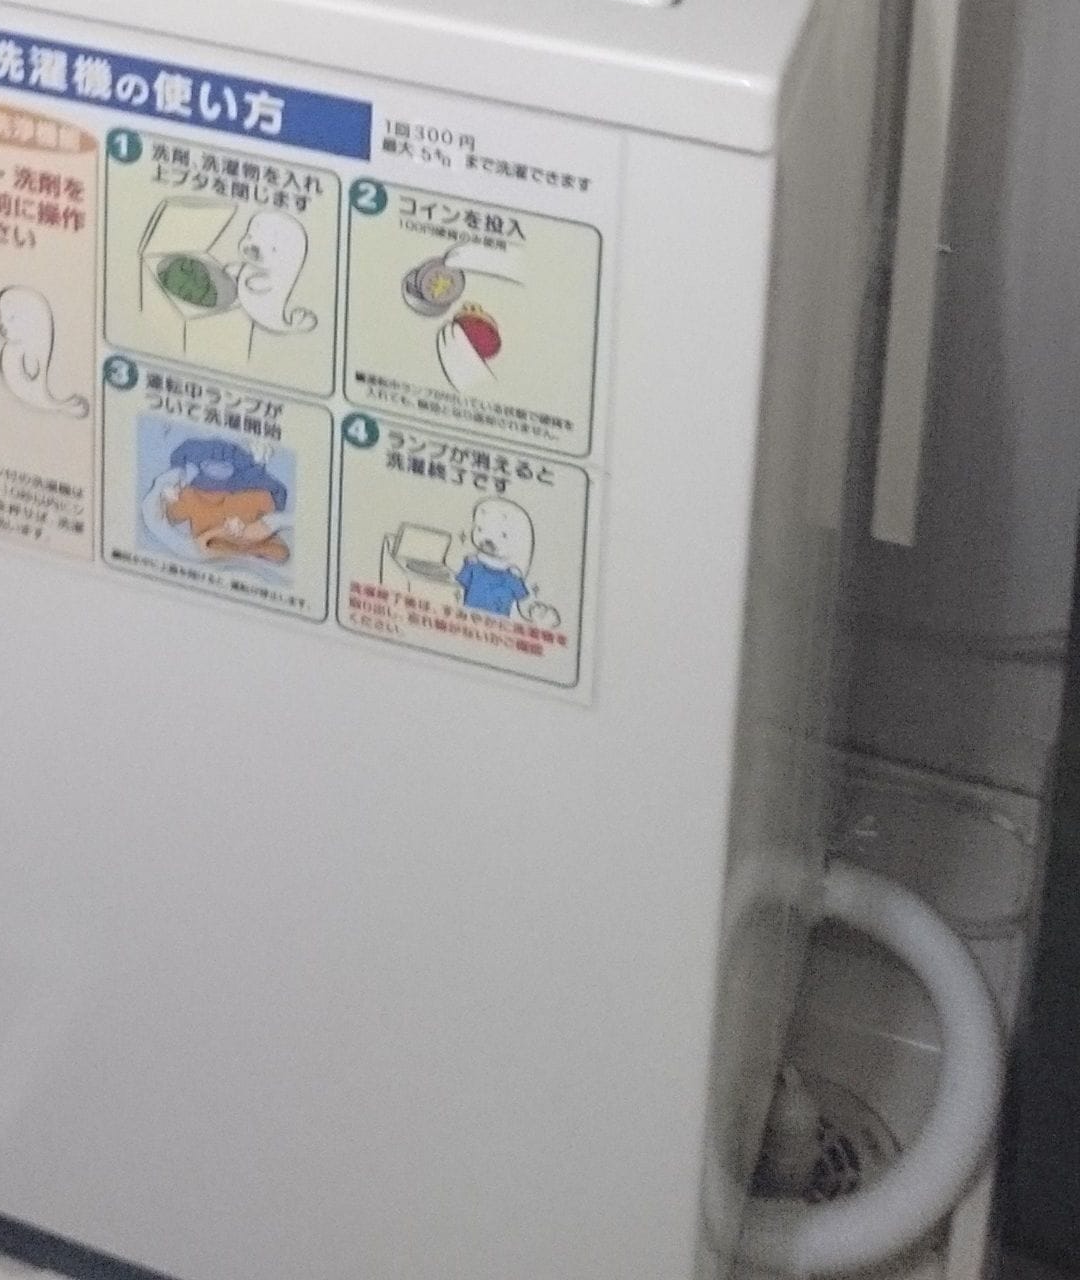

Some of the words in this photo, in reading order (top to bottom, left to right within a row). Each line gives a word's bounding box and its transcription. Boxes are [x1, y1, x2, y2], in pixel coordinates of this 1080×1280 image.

[399, 194, 527, 242] コインを投入
[385, 449, 510, 494] 洗濯終了です
